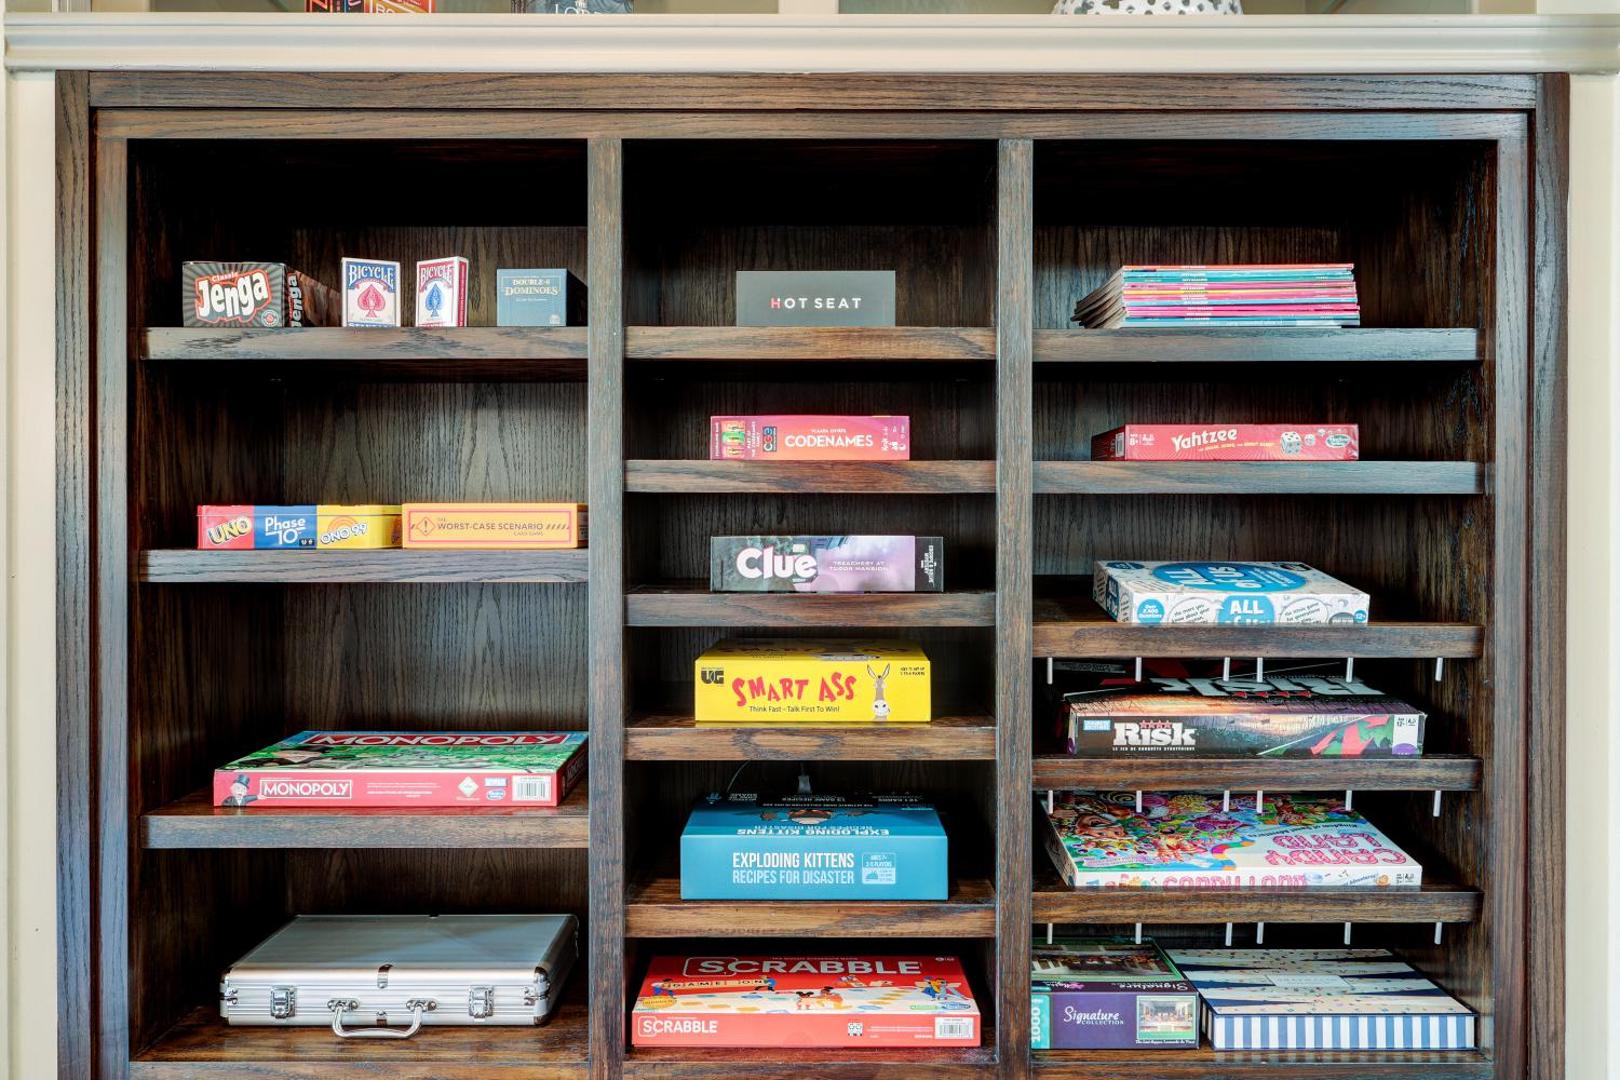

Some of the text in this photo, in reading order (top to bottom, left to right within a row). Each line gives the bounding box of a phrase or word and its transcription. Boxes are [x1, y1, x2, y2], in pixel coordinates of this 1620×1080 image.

[349, 265, 394, 289] BICYCLE
[420, 265, 453, 290] BICYCLE
[198, 272, 268, 318] Jenga
[505, 286, 559, 296] DOMINOES
[770, 297, 862, 309] HOT SEAT
[785, 434, 874, 448] CODENAMES
[1171, 428, 1238, 452] Yahtzee
[207, 516, 251, 544] UNO
[265, 515, 306, 532] Phase
[276, 529, 300, 545] 10
[320, 521, 368, 544] ONO 99
[736, 545, 818, 579] Clue
[1230, 599, 1264, 615] ALL
[731, 672, 857, 707] SMART ASS
[749, 705, 840, 713] Think Fast Talk First To Win!
[312, 735, 562, 746] MONOPOLY
[264, 782, 349, 796] MONOPOLY
[1272, 832, 1382, 849] LAND
[733, 853, 855, 868] EXPLODING KITTENS
[1264, 848, 1407, 866] CANDY
[733, 870, 855, 884] RECIPES FOR DISASTER
[698, 960, 922, 974] SCRABBLE
[1119, 982, 1188, 991] Signature
[1063, 1005, 1120, 1024] Signature
[643, 1020, 718, 1033] SCRABBLE
